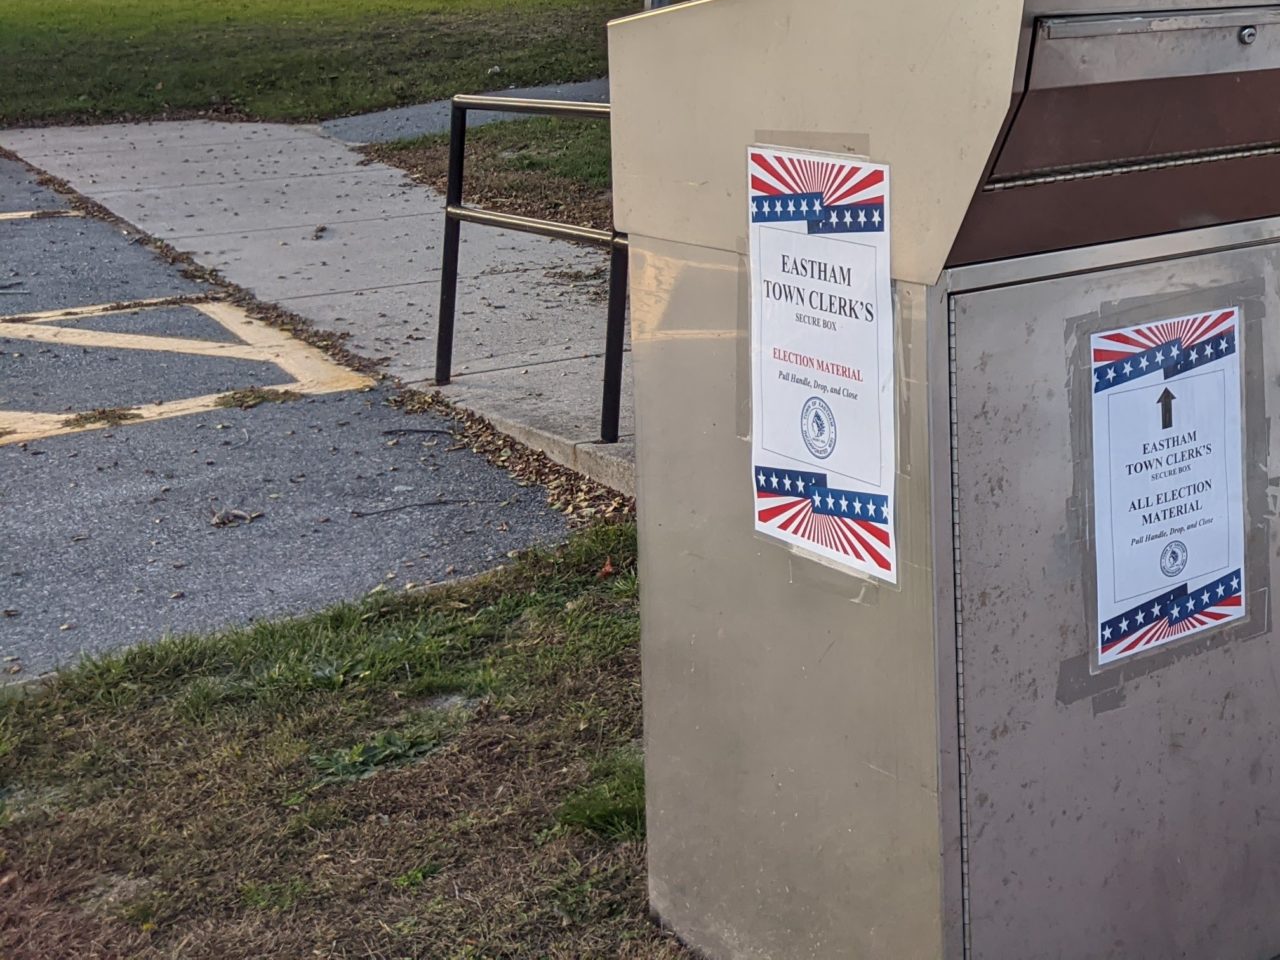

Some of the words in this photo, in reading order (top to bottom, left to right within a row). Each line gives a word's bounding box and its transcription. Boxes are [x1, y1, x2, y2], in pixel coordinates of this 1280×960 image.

[781, 254, 852, 287] EASTHAM
[763, 279, 806, 307] TOWN
[808, 290, 874, 323] CLERK'S
[795, 312, 821, 328] SECURE
[822, 319, 837, 331] BOX
[773, 347, 815, 369] ELECTION
[816, 359, 864, 382] MATERIAL
[778, 370, 790, 381] Pull
[790, 373, 812, 388] Handle,
[813, 380, 829, 394] Drop,
[830, 386, 841, 395] and
[842, 387, 858, 400] Close
[1142, 430, 1197, 455] EASTHAM
[1125, 456, 1163, 476] TOWN
[1166, 443, 1212, 466] CLERK'S
[1151, 468, 1177, 481] SECURE
[1178, 464, 1191, 474] BOX
[1128, 496, 1153, 512] ALL
[1156, 478, 1212, 505] ELECTION
[1142, 499, 1203, 526] MATERIAL
[1131, 536, 1144, 546] Pull
[1186, 520, 1197, 530] and
[1198, 517, 1213, 527] Close
